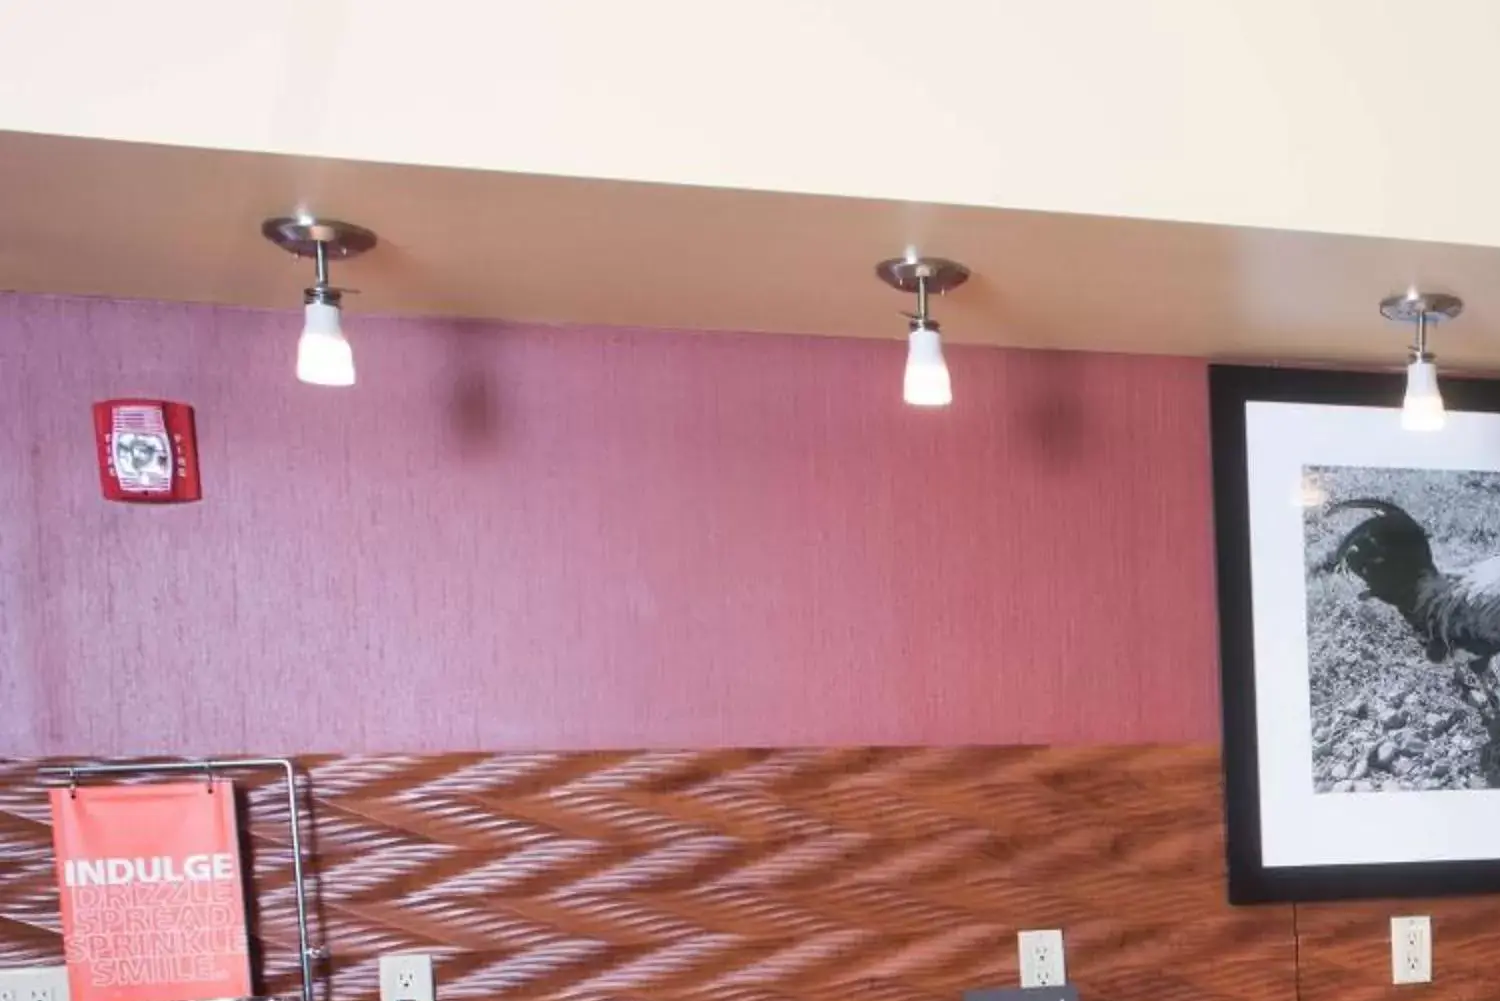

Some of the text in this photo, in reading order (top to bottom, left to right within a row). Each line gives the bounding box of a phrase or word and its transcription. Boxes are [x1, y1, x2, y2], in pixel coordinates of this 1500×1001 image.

[65, 852, 236, 887] INDULGE
[73, 881, 234, 911] DRIZZLE
[74, 904, 236, 935] SPREAD
[65, 927, 247, 963] SPRINKLE
